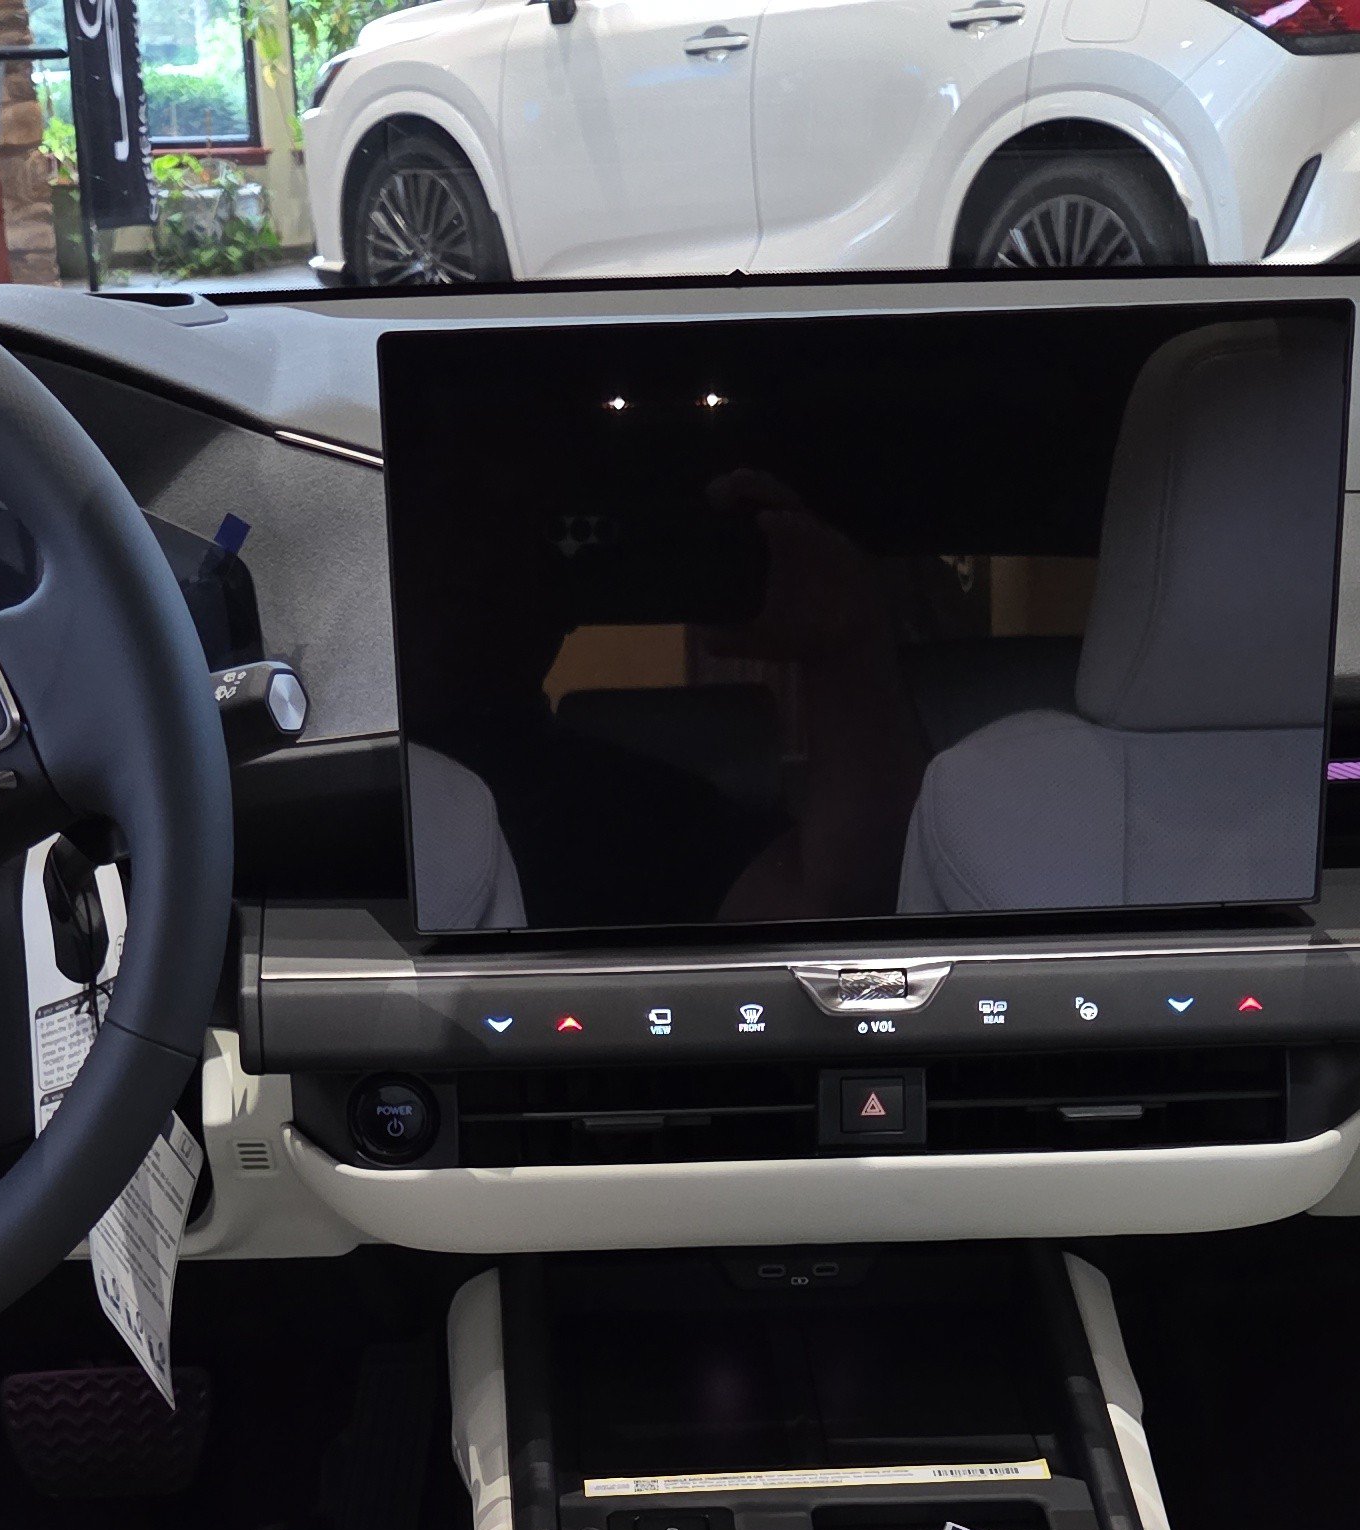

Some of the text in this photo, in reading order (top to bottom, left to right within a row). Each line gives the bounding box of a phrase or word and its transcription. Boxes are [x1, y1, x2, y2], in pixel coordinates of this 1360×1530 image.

[983, 1015, 1005, 1024] REAR
[650, 1025, 671, 1035] VIEW
[738, 1023, 766, 1033] FRONT
[871, 1021, 896, 1033] VOL
[376, 1105, 413, 1116] POWER
